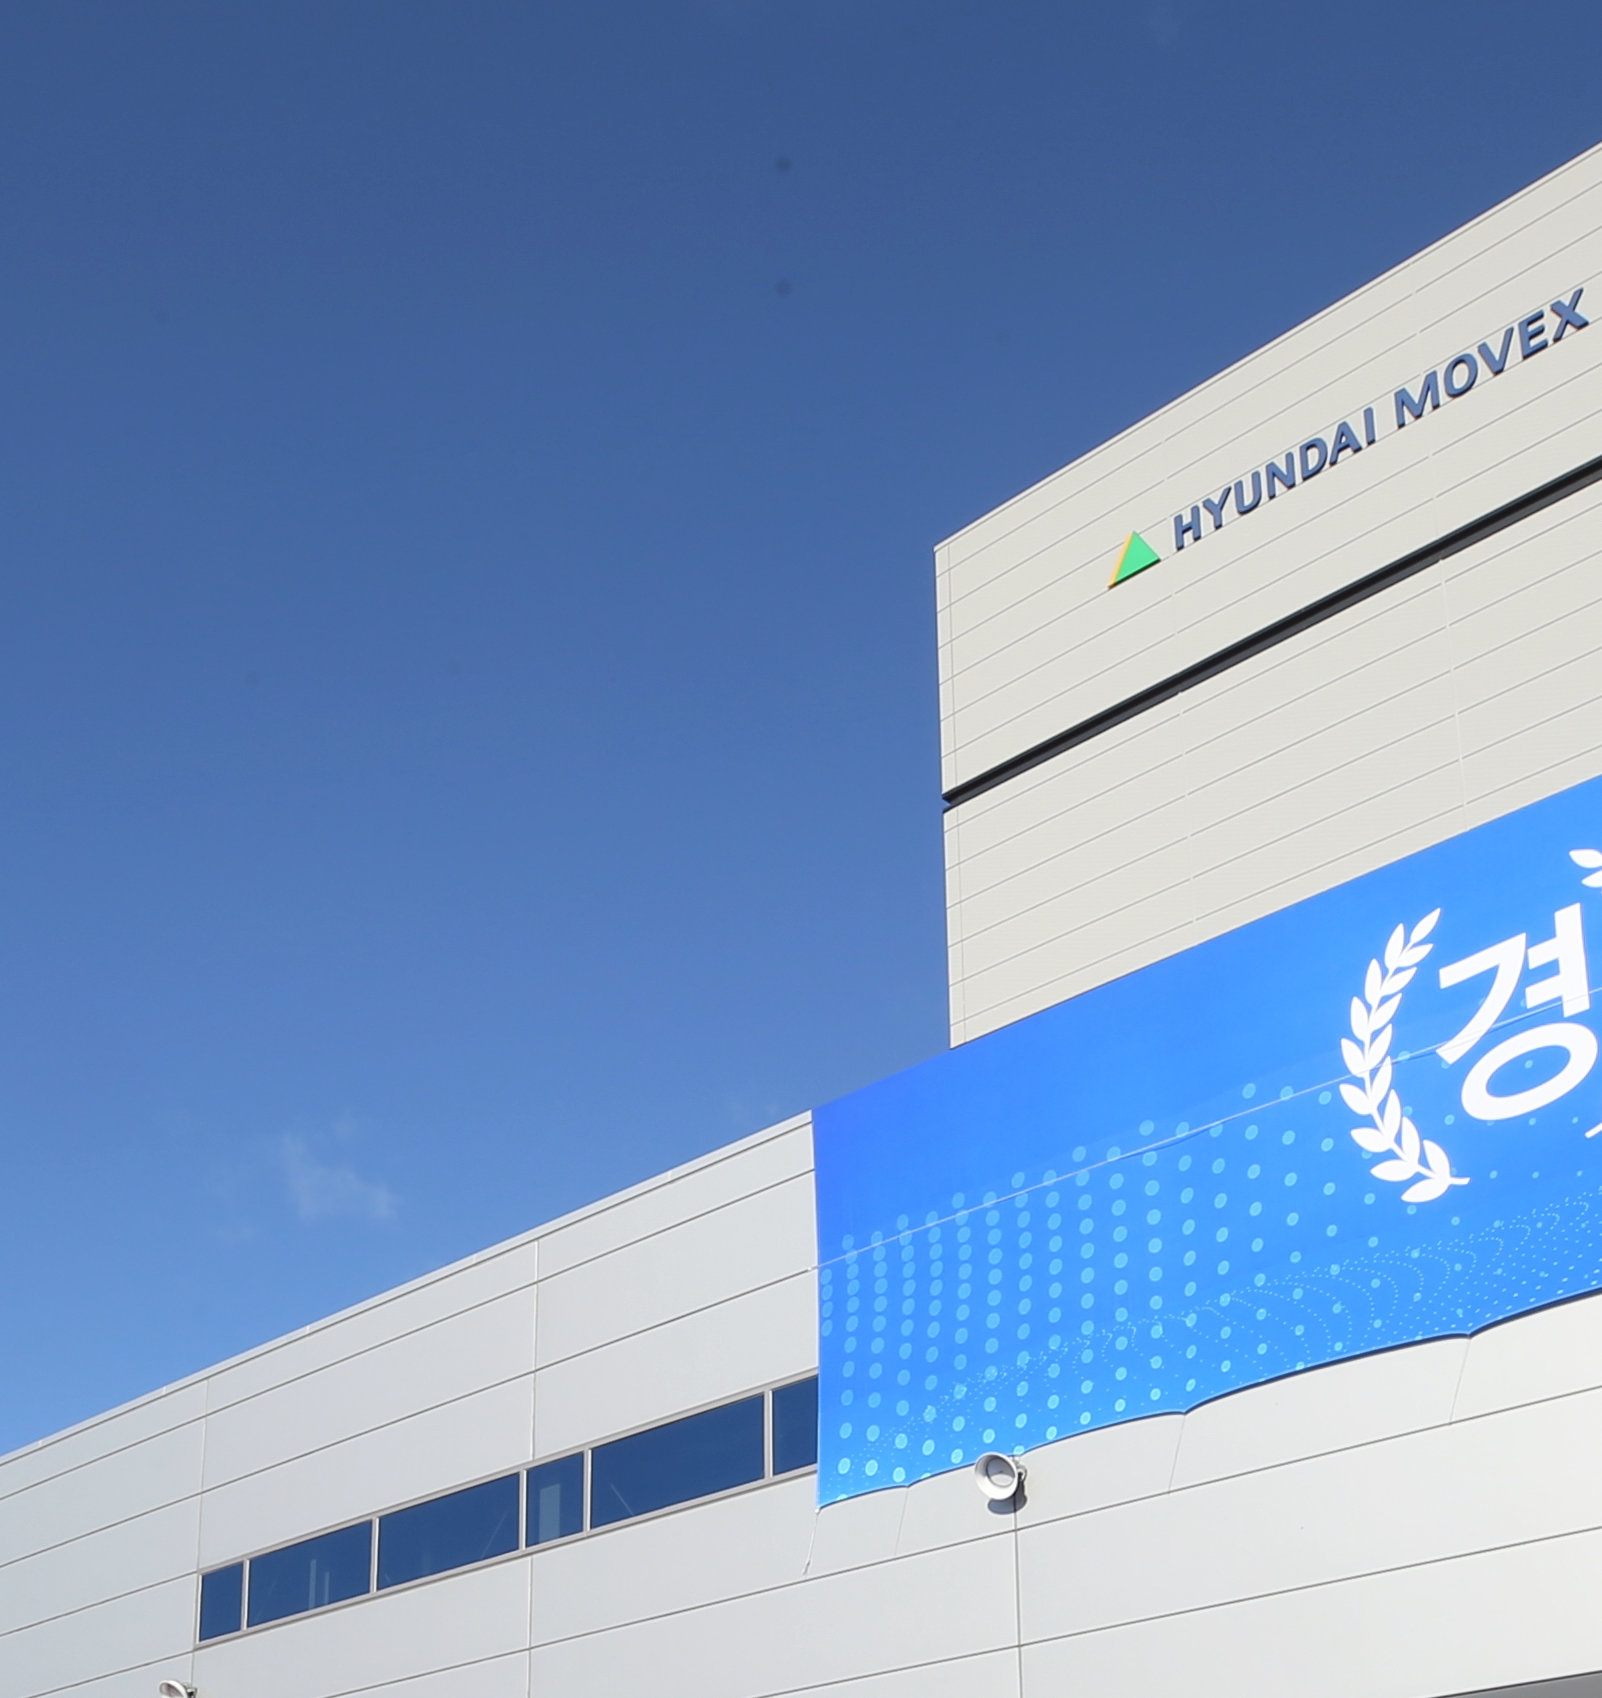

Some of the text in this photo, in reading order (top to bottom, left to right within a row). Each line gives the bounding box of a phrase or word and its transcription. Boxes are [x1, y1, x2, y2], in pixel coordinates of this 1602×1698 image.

[1173, 287, 1590, 552] HYUNDAI MOVEX
[1435, 902, 1598, 1121] 경
